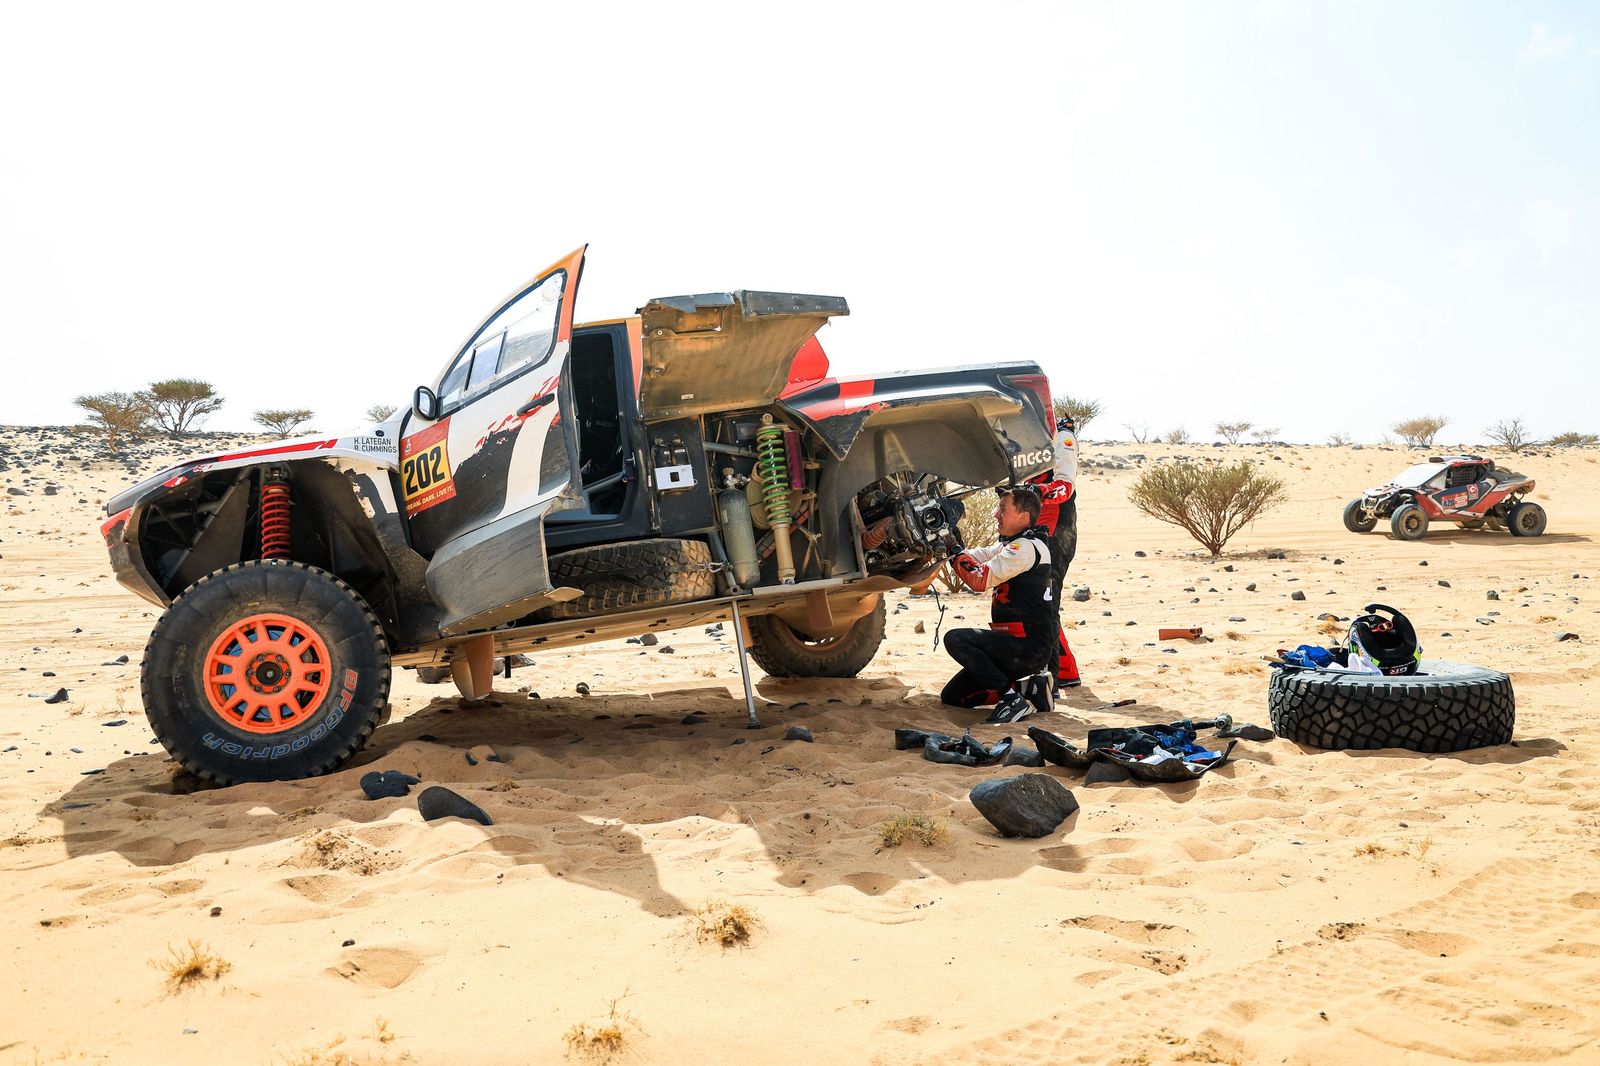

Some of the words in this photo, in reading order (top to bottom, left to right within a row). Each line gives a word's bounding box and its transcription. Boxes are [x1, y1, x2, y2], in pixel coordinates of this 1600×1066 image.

[353, 437, 360, 445] H.
[361, 437, 392, 446] LATEGAN
[361, 444, 397, 454] CUMMINGS
[403, 445, 446, 496] 202
[202, 668, 358, 760] BFGoodrich
